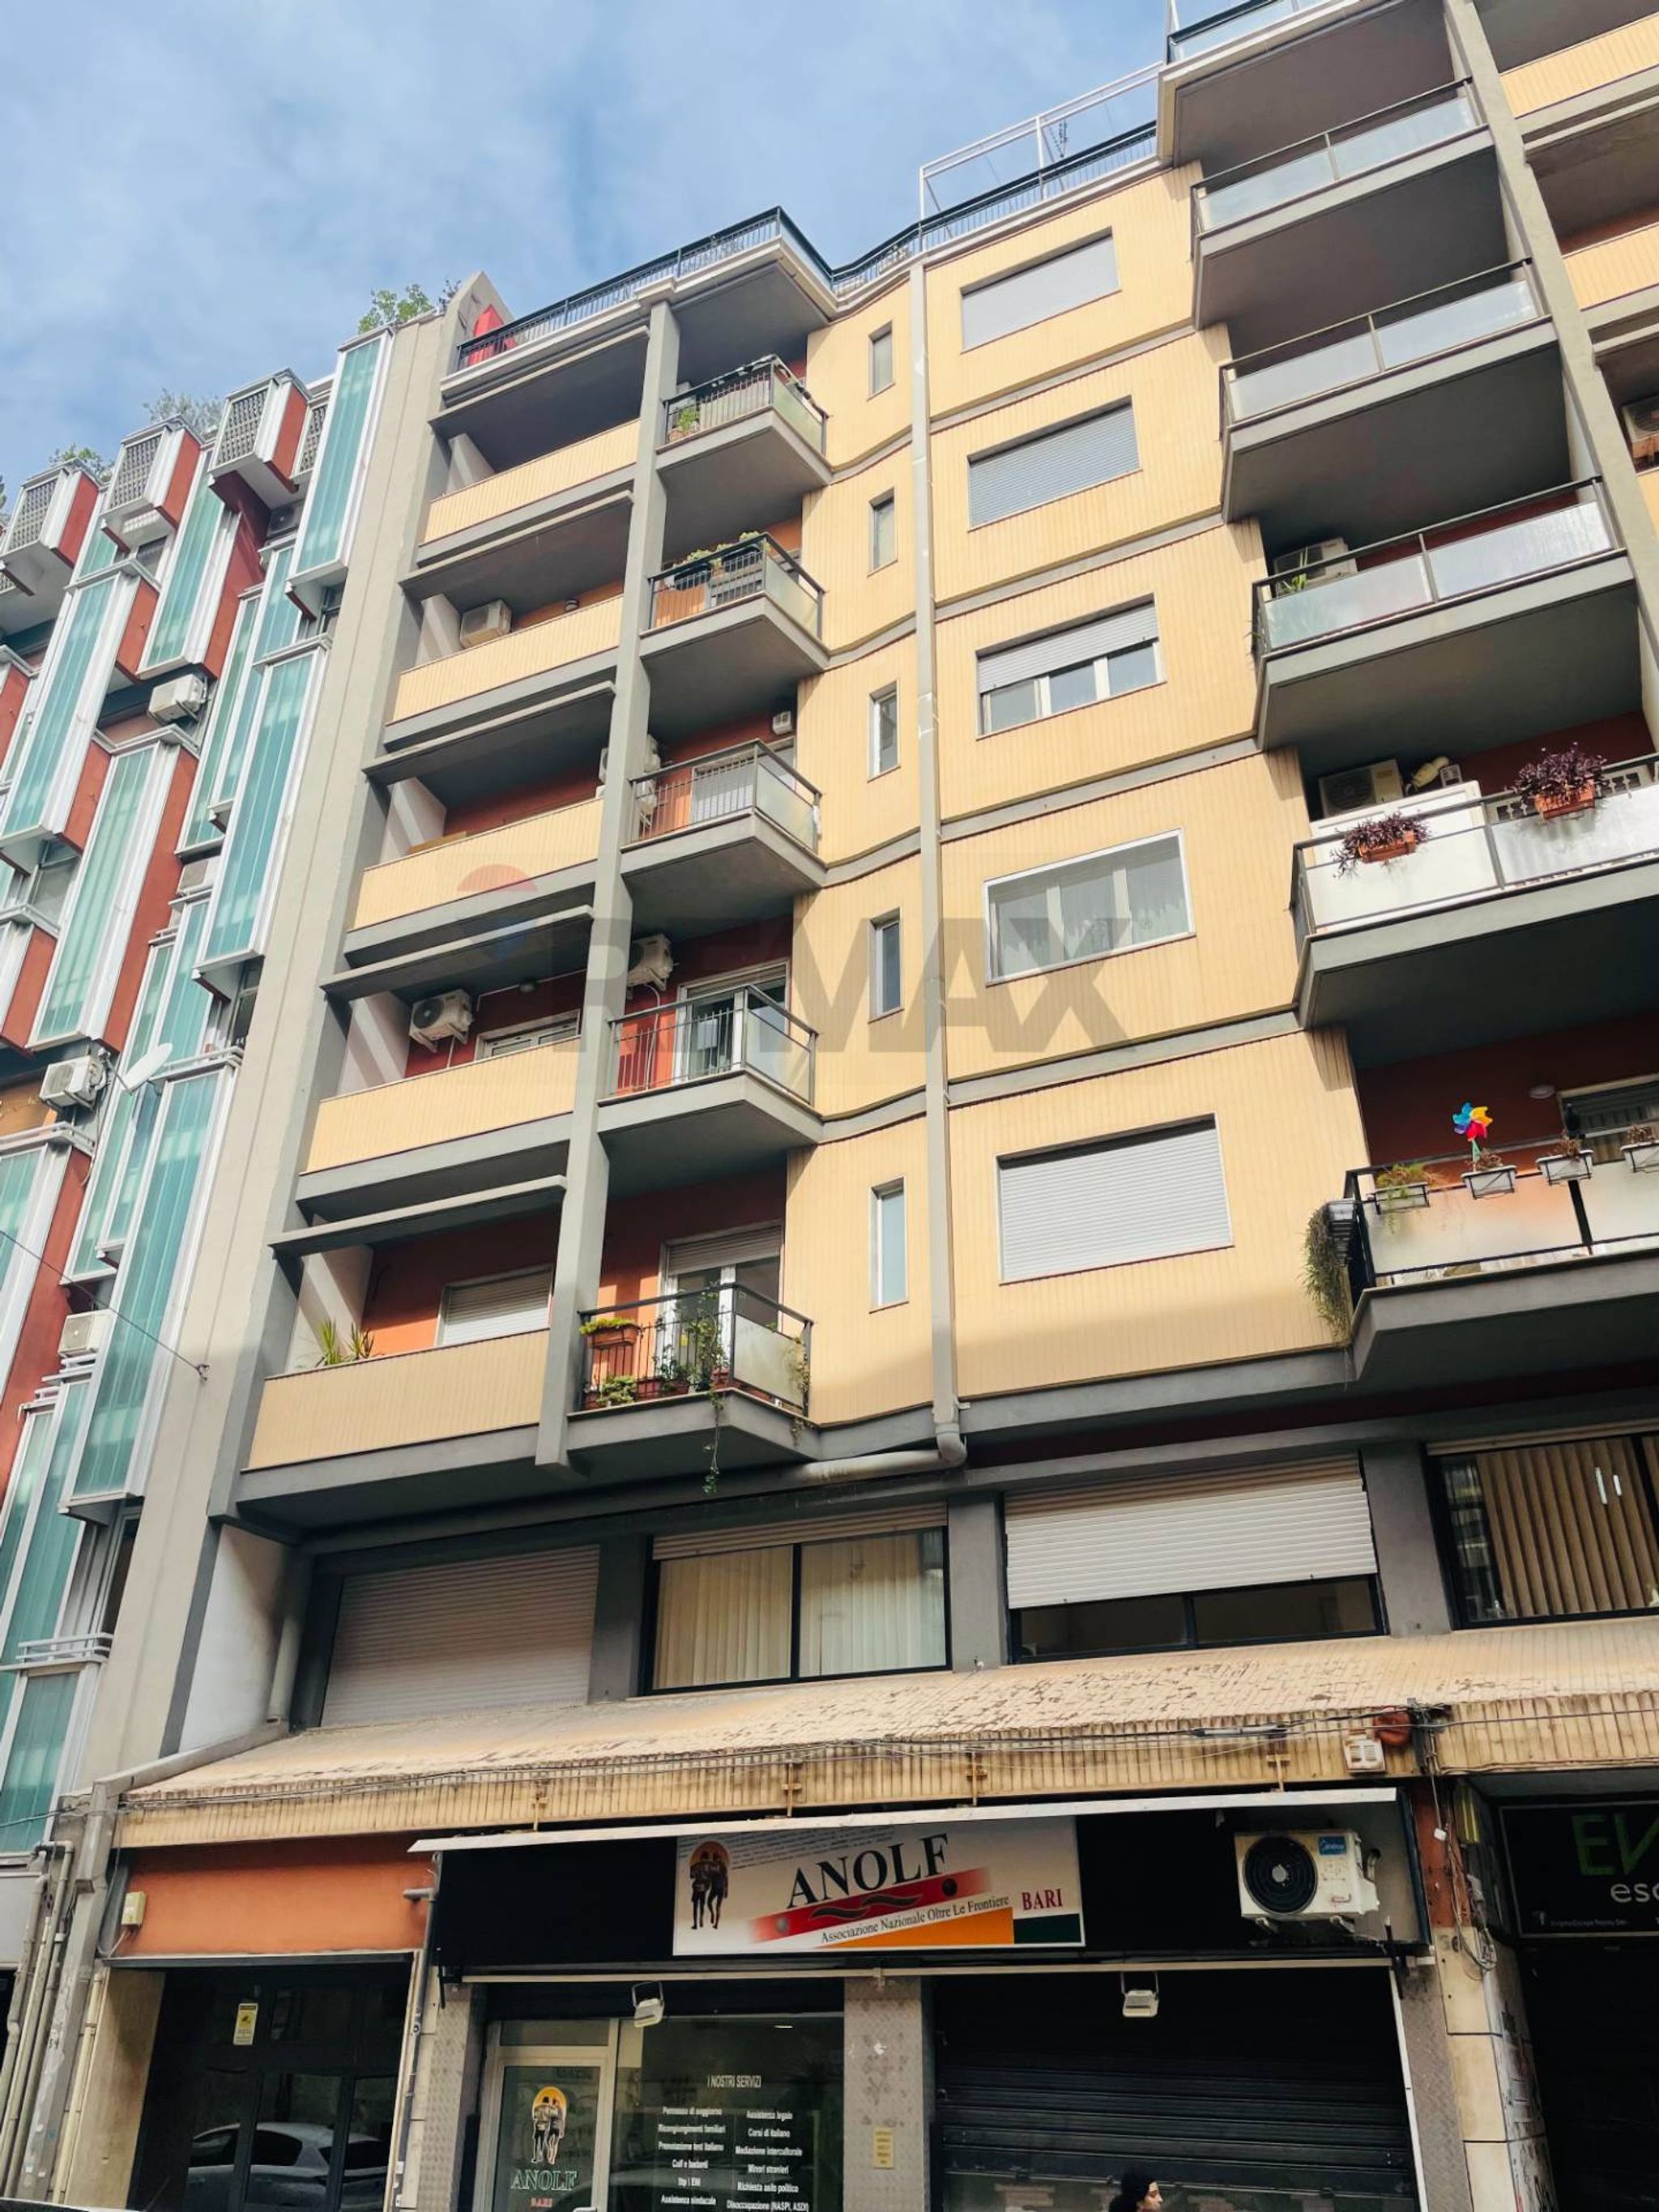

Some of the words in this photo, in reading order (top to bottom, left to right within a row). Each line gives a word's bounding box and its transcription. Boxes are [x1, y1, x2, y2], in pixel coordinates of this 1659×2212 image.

[787, 1833, 949, 1910] ANOLF
[1021, 1889, 1064, 1911] BARI
[821, 1924, 879, 1944] Associazione
[881, 1913, 926, 1932] Nazionale
[927, 1907, 951, 1922] Oltre
[953, 1903, 966, 1916] Le
[966, 1895, 1009, 1914] Frontiere
[710, 2075, 736, 2088] NOSTRI
[736, 2075, 761, 2088] SERVIZI
[748, 2128, 763, 2137] Corsi
[764, 2129, 770, 2137] di
[510, 2169, 578, 2191] ANOLF
